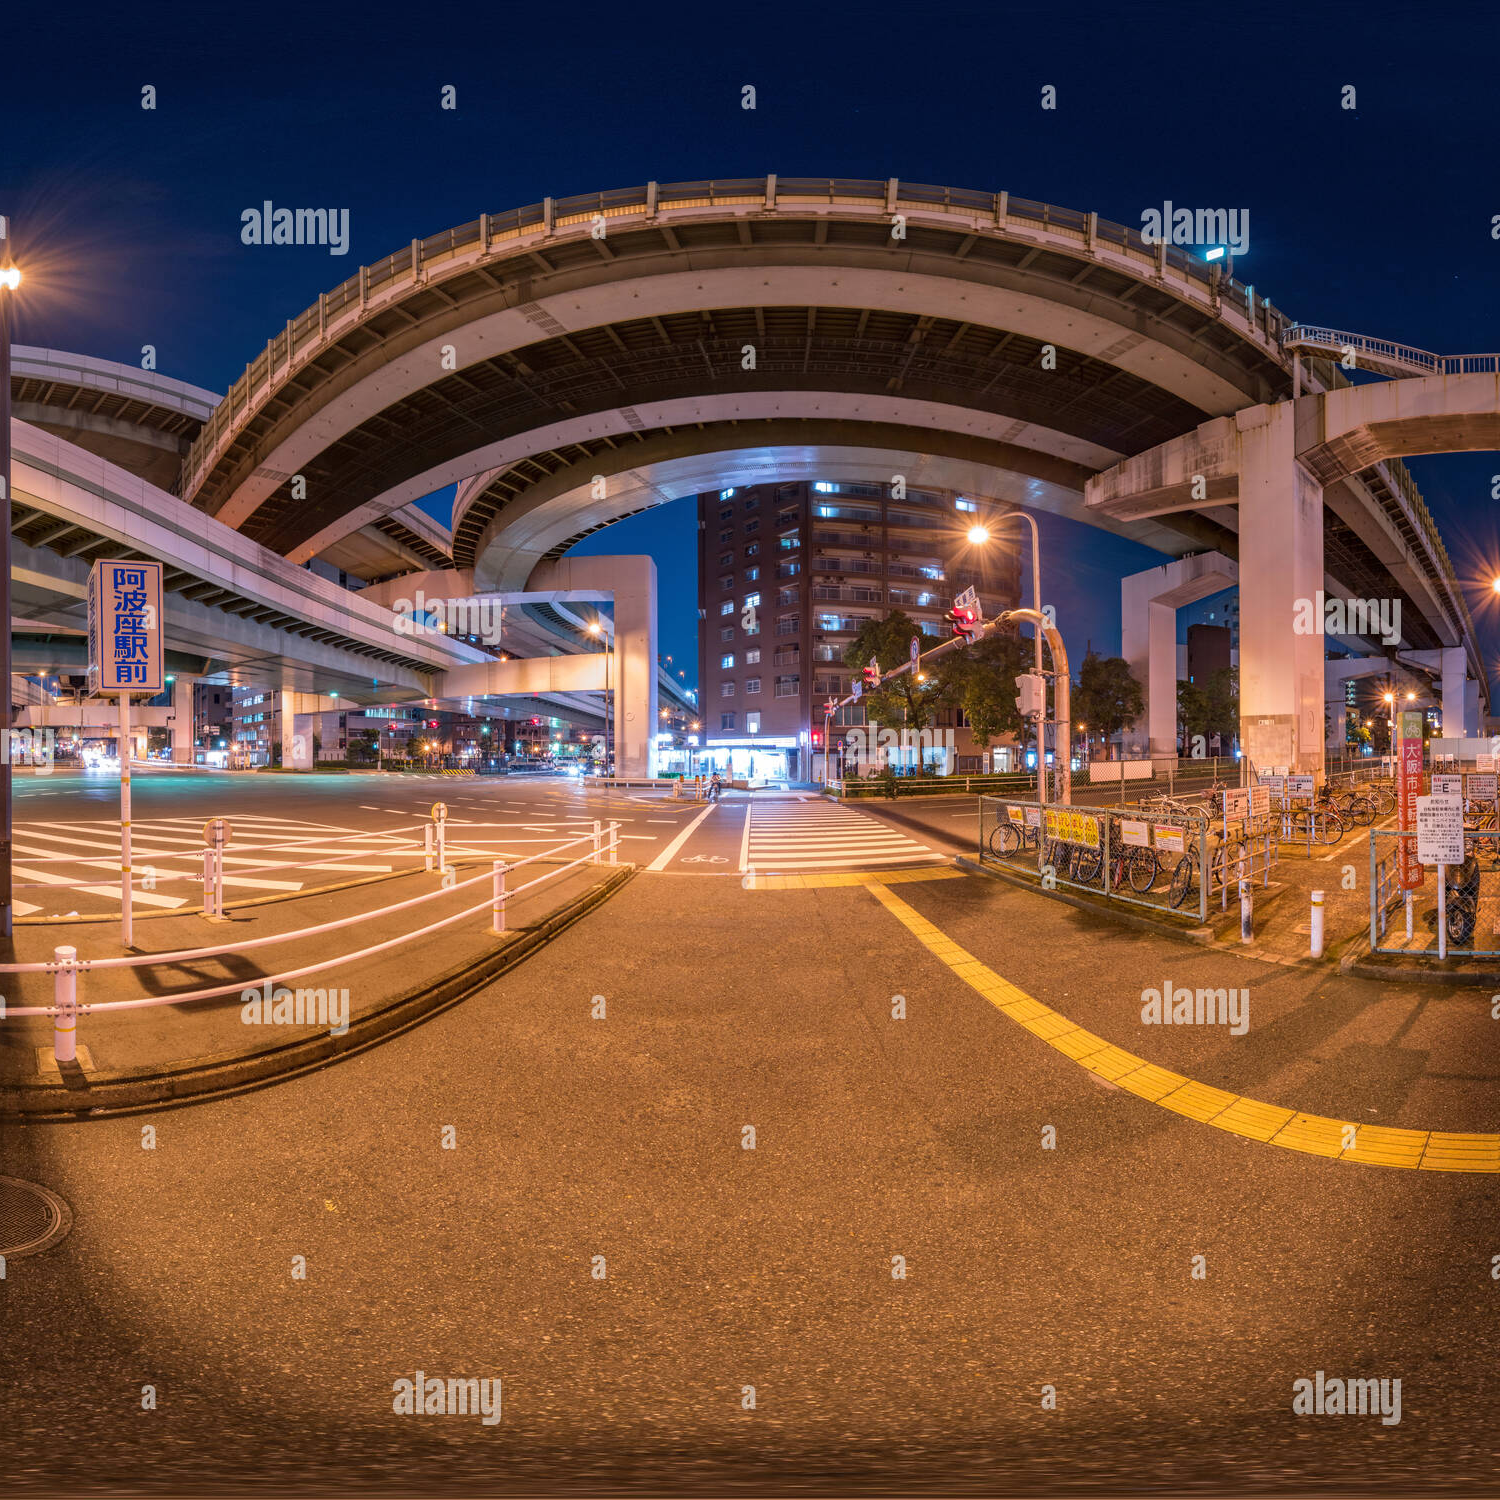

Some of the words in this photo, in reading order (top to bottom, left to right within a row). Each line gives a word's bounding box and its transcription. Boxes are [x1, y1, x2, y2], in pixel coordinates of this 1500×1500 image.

[113, 568, 148, 683] 阿波座駅前
[1296, 783, 1302, 792] F
[1442, 783, 1449, 792] E
[1233, 800, 1239, 812] F
